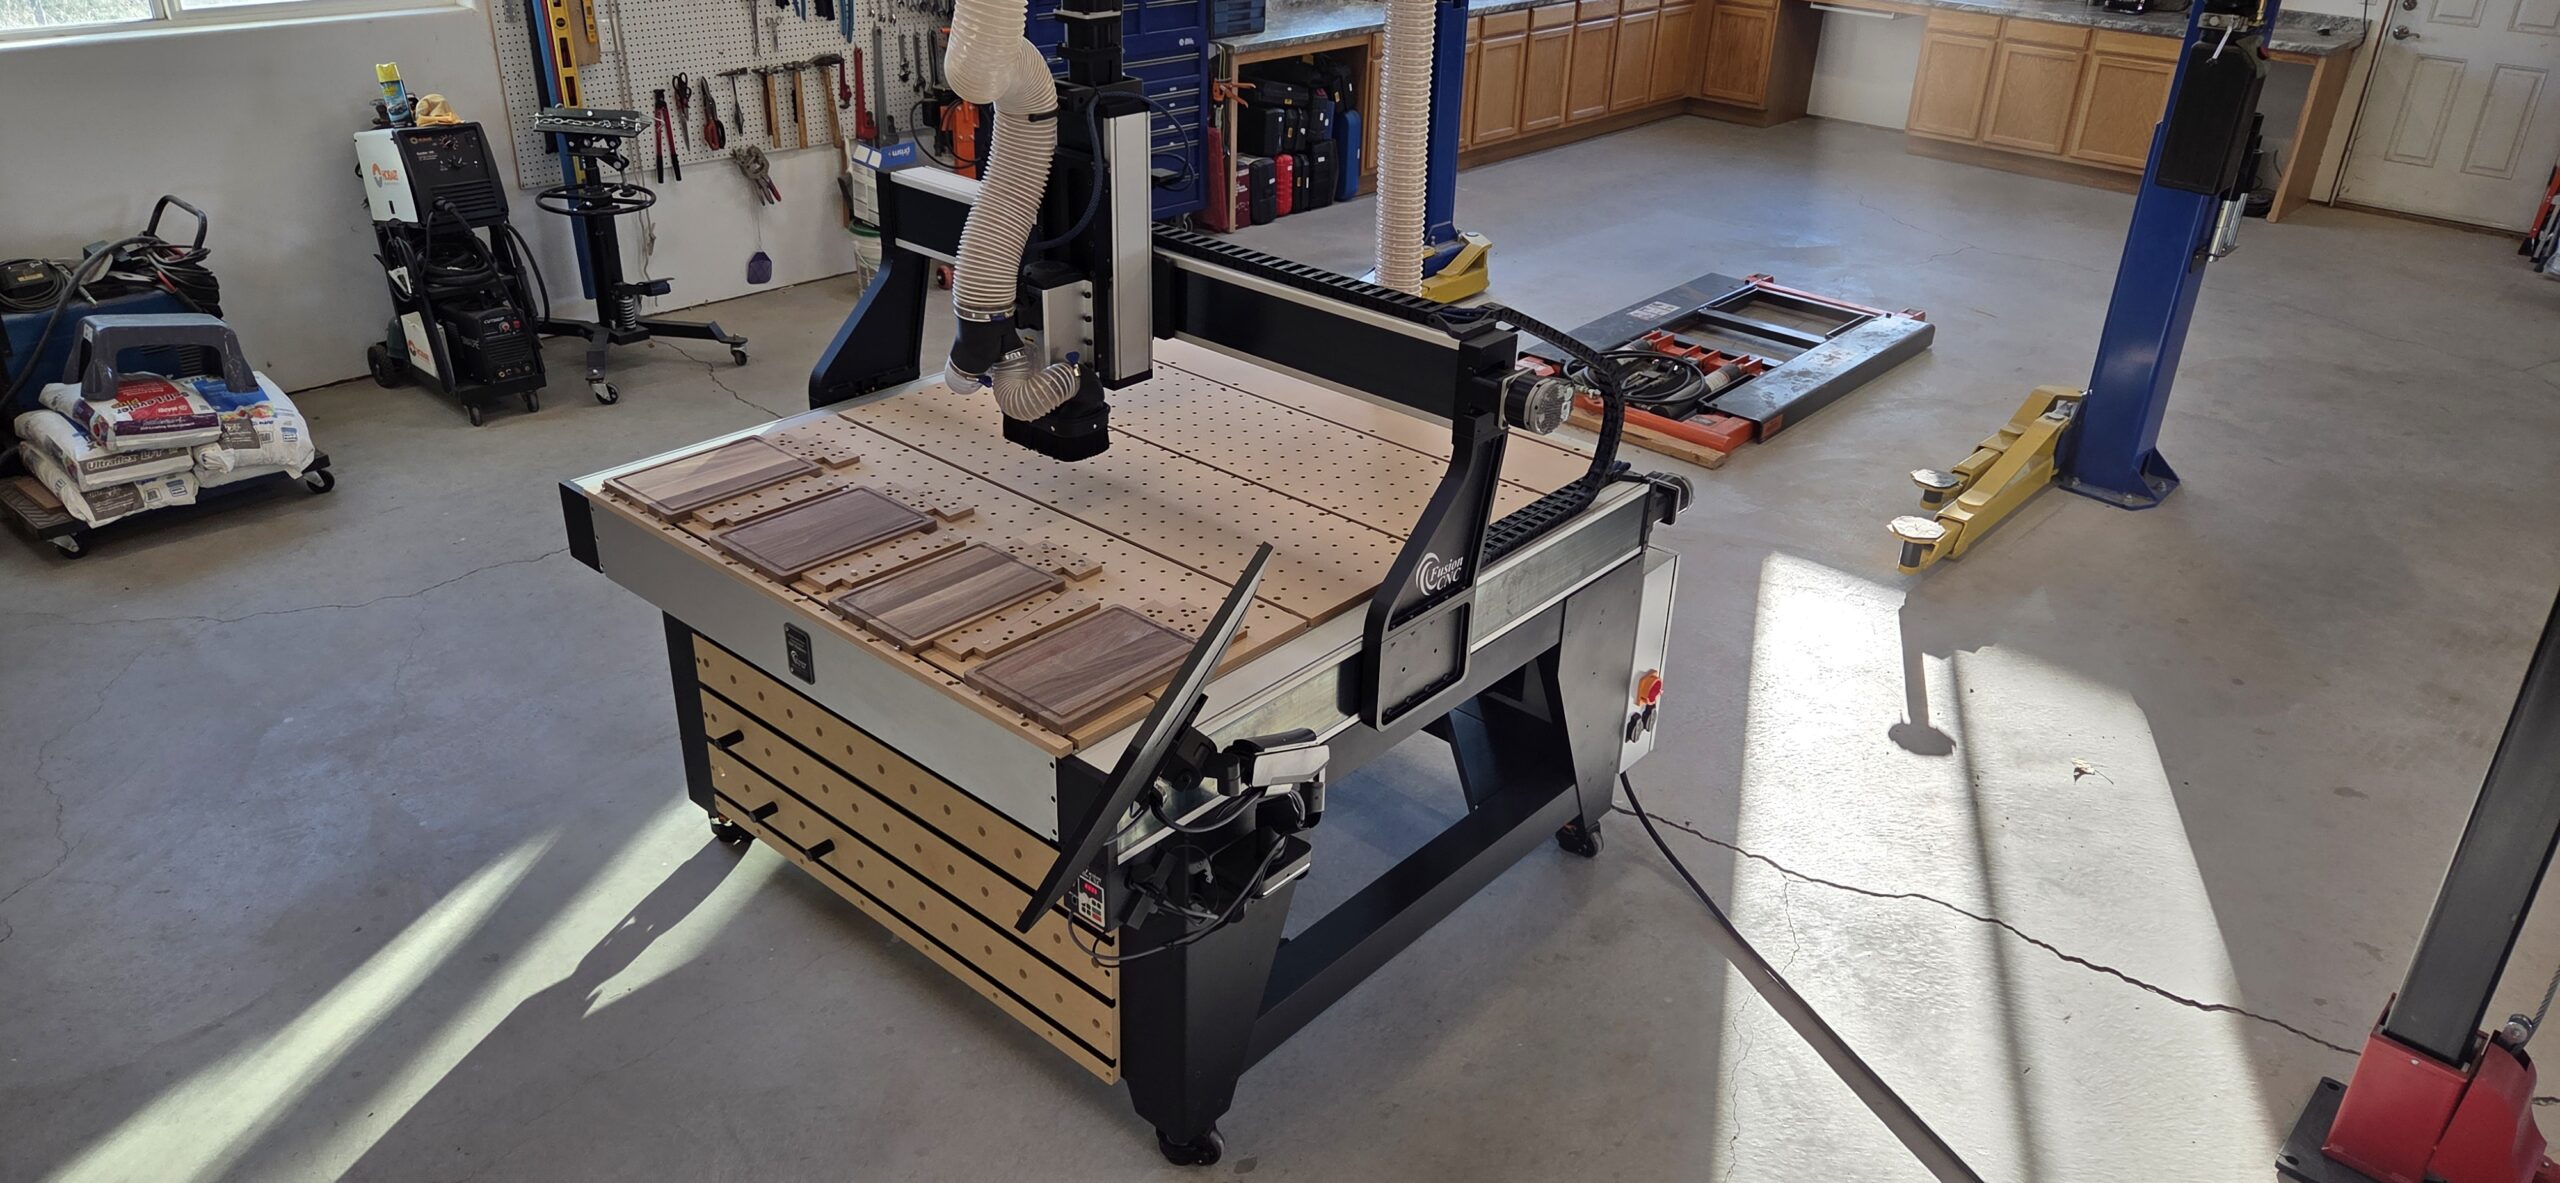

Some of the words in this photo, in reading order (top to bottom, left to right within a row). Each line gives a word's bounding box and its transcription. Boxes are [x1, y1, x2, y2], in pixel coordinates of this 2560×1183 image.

[117, 397, 164, 415] Leveler
[86, 453, 138, 471] Ultraflex
[1430, 556, 1464, 582] Fusion
[1436, 567, 1462, 591] CNC
